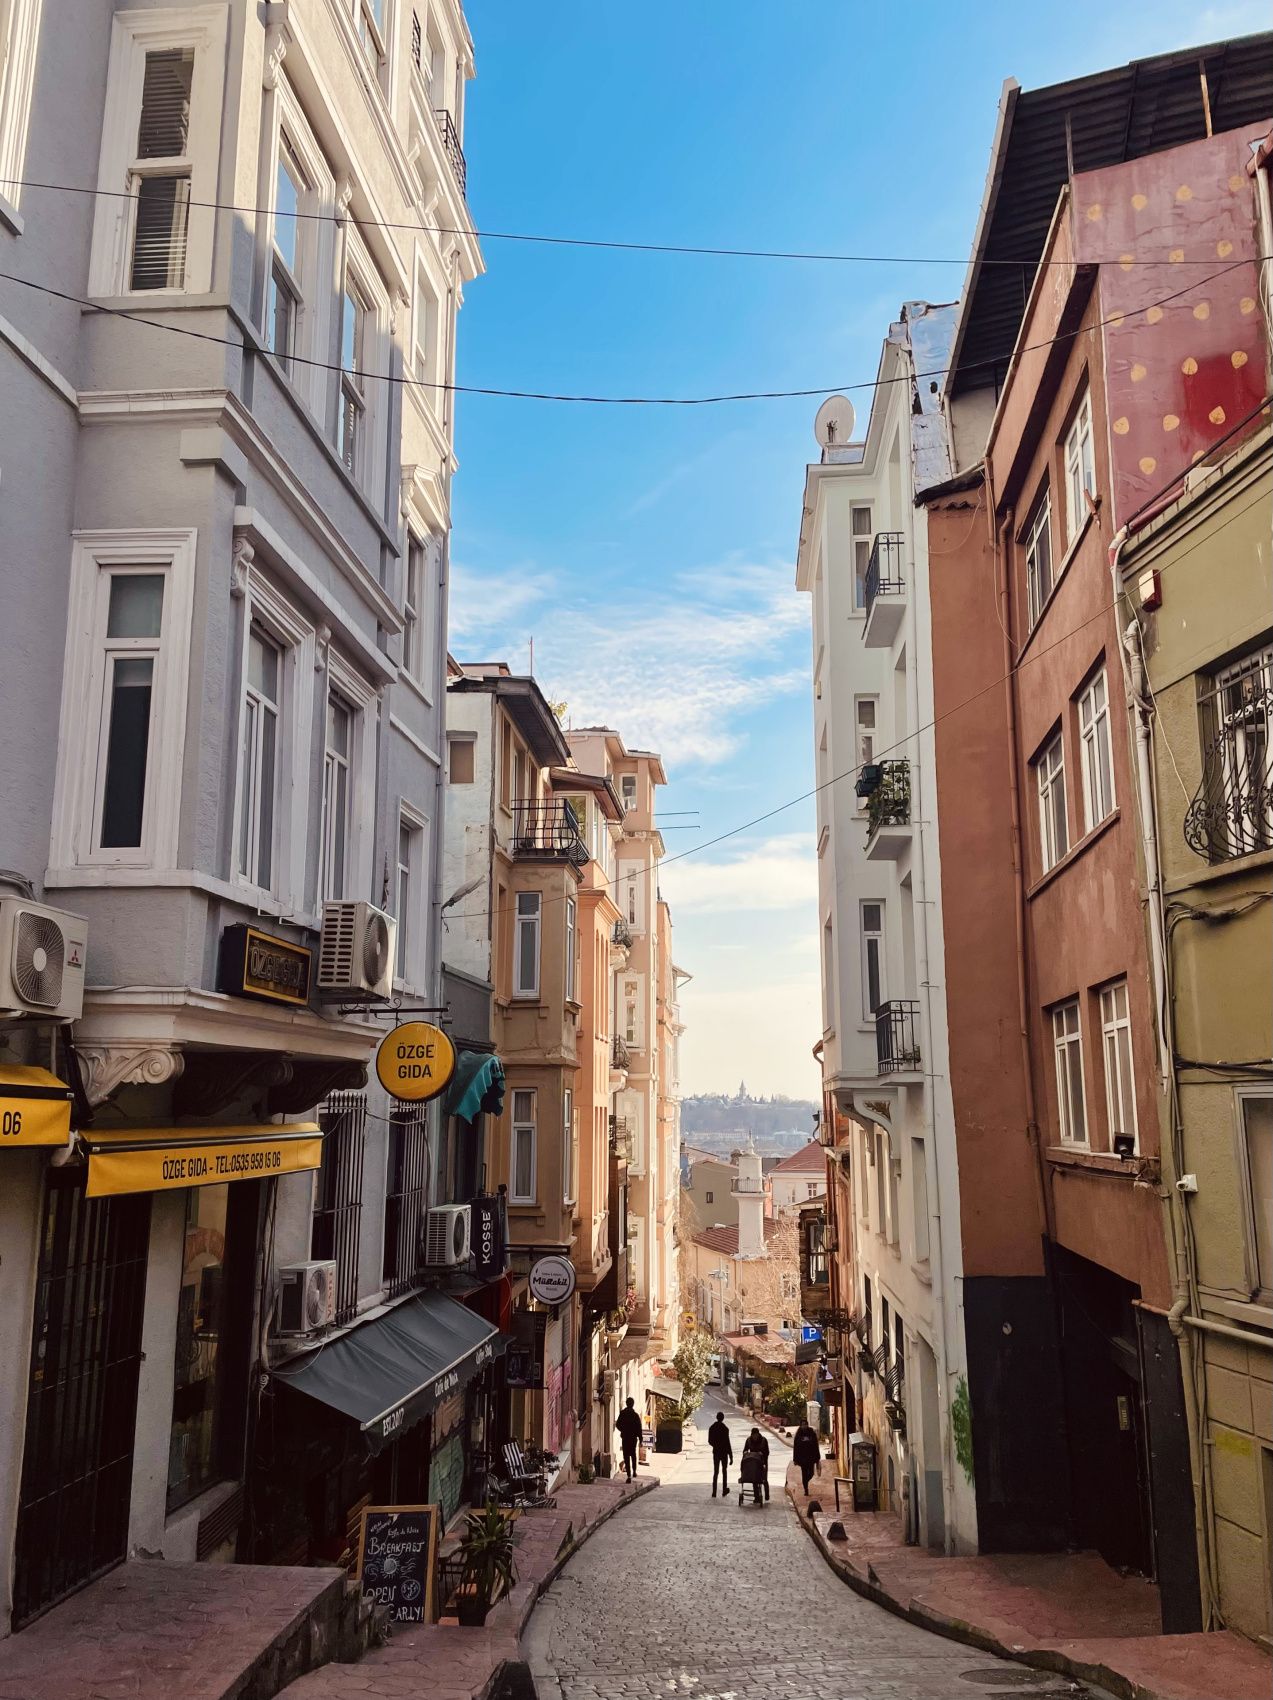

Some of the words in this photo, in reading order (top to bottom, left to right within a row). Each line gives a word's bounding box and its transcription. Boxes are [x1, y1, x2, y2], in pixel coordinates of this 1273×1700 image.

[397, 1042, 435, 1059] ÖZGE
[397, 1064, 432, 1079] GIDA
[2, 1111, 22, 1136] 06
[162, 1156, 187, 1180] ÖZGE
[187, 1158, 208, 1177] GIDA
[215, 1154, 249, 1174] TEL:0535
[250, 1152, 264, 1170] 958
[272, 1150, 281, 1167] 06
[482, 1212, 491, 1264] KOSSE
[809, 1328, 817, 1338] P
[367, 1537, 425, 1555] BREAKFAST
